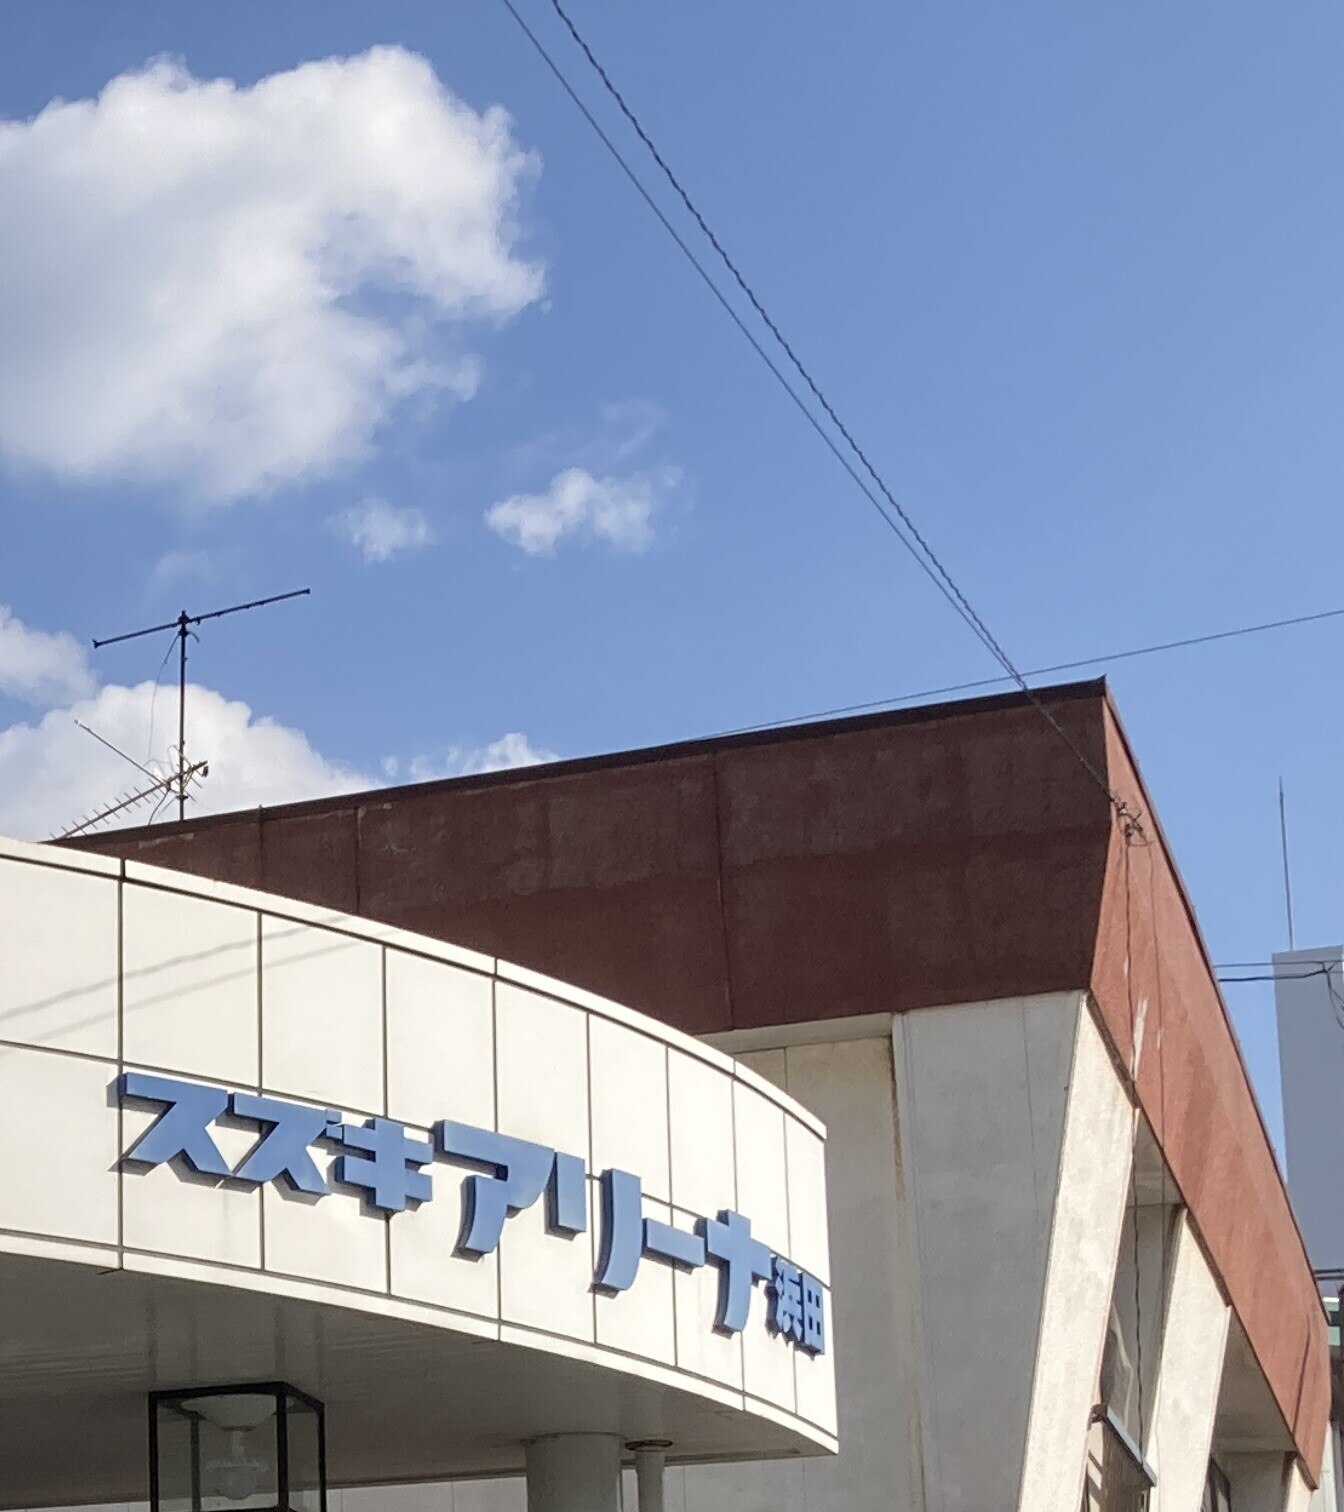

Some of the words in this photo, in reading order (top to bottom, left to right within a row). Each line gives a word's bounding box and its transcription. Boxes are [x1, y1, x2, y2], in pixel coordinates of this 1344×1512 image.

[118, 1072, 826, 1356] スズキアリーナ浜田
